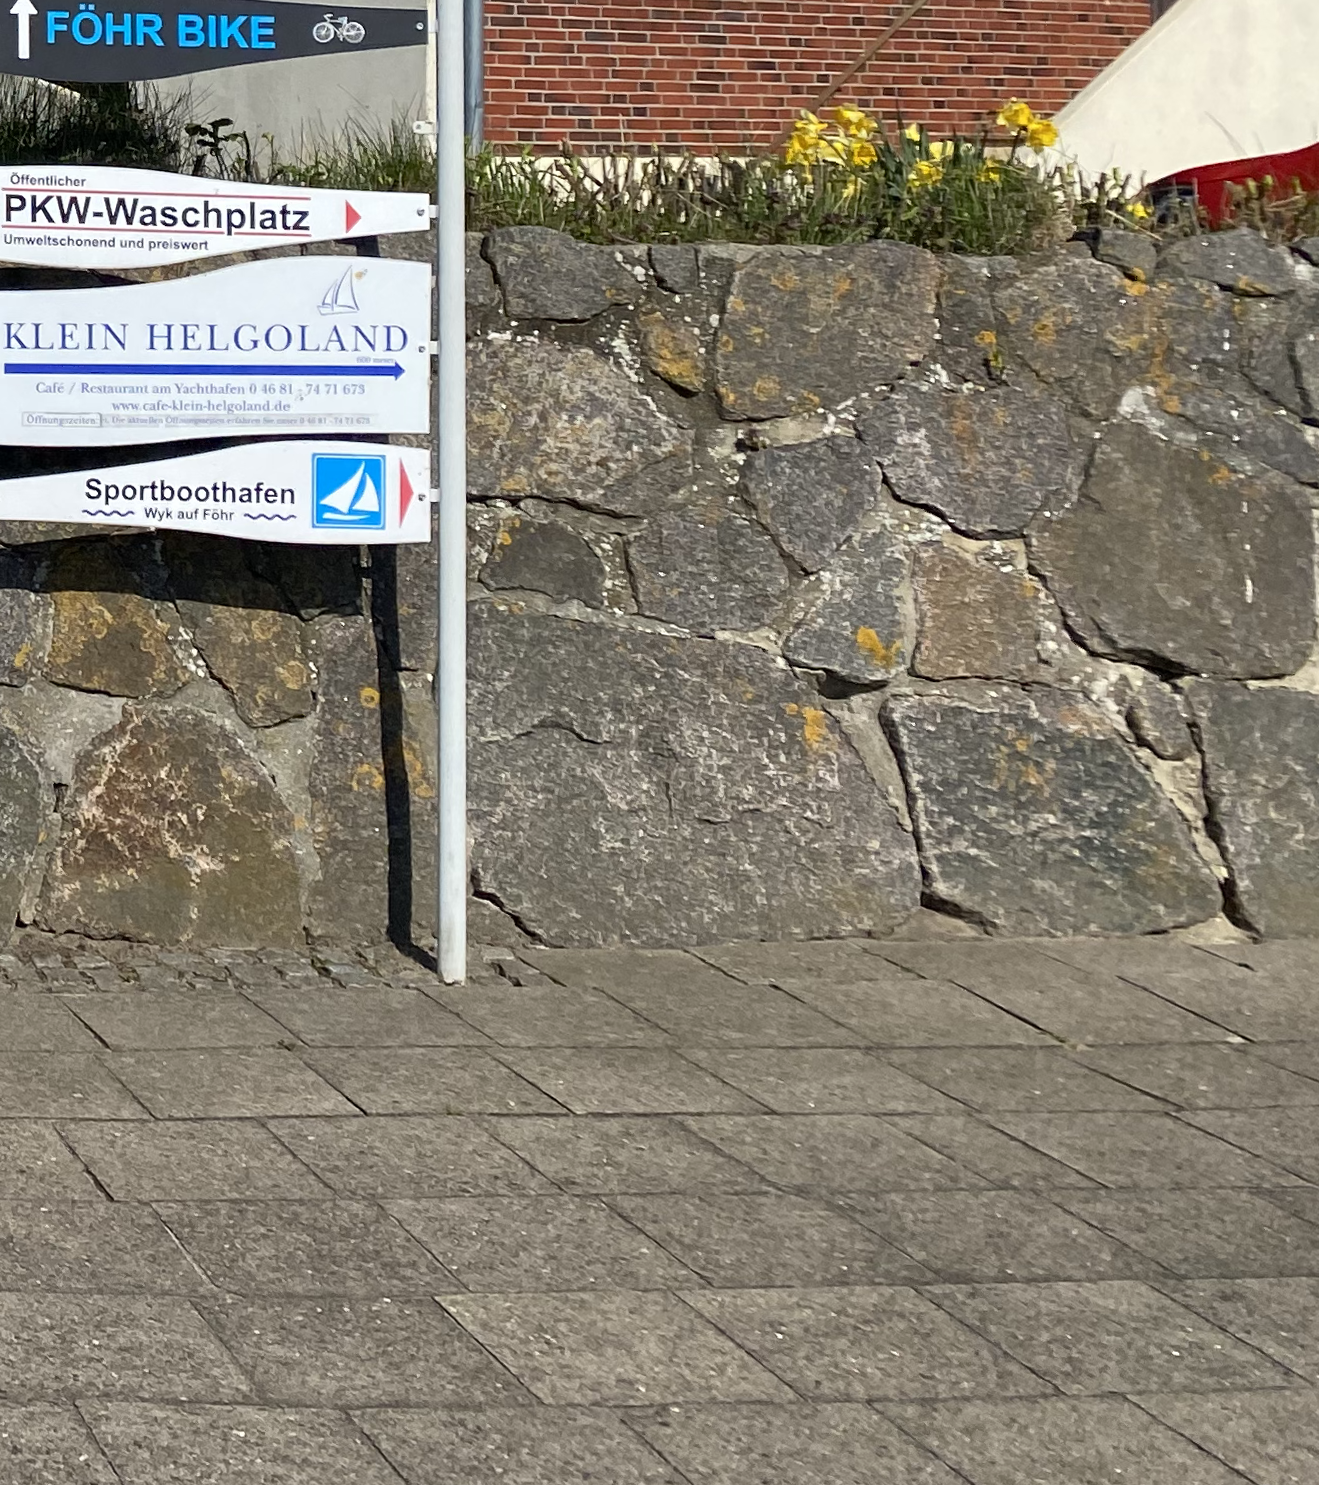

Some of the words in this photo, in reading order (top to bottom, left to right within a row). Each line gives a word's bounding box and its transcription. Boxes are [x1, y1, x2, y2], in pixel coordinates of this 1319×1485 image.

[46, 3, 165, 47] FÖHR
[177, 13, 276, 49] BIKE
[10, 171, 87, 187] Öffentlicher
[4, 193, 311, 236] PKW-Waschplatz
[3, 233, 116, 249] Umweltschonend
[119, 236, 145, 249] und
[148, 237, 210, 252] preiswert
[3, 322, 129, 351] KLEIN
[146, 322, 409, 353] HELGOLAND
[35, 381, 66, 394] Café
[80, 382, 150, 395] Restaurant
[152, 385, 172, 395] am
[174, 382, 246, 396] Yachthafen
[249, 383, 258, 395] 0
[261, 383, 277, 395] 46
[279, 383, 293, 395] 81
[306, 383, 321, 396] 74
[324, 383, 339, 396] 71
[111, 399, 292, 414] www.cafe-klein-helgoland.de
[84, 477, 296, 506] Sportboothafen
[144, 507, 173, 523] Wyk
[177, 508, 201, 521] auf
[203, 508, 235, 522] Föhr
